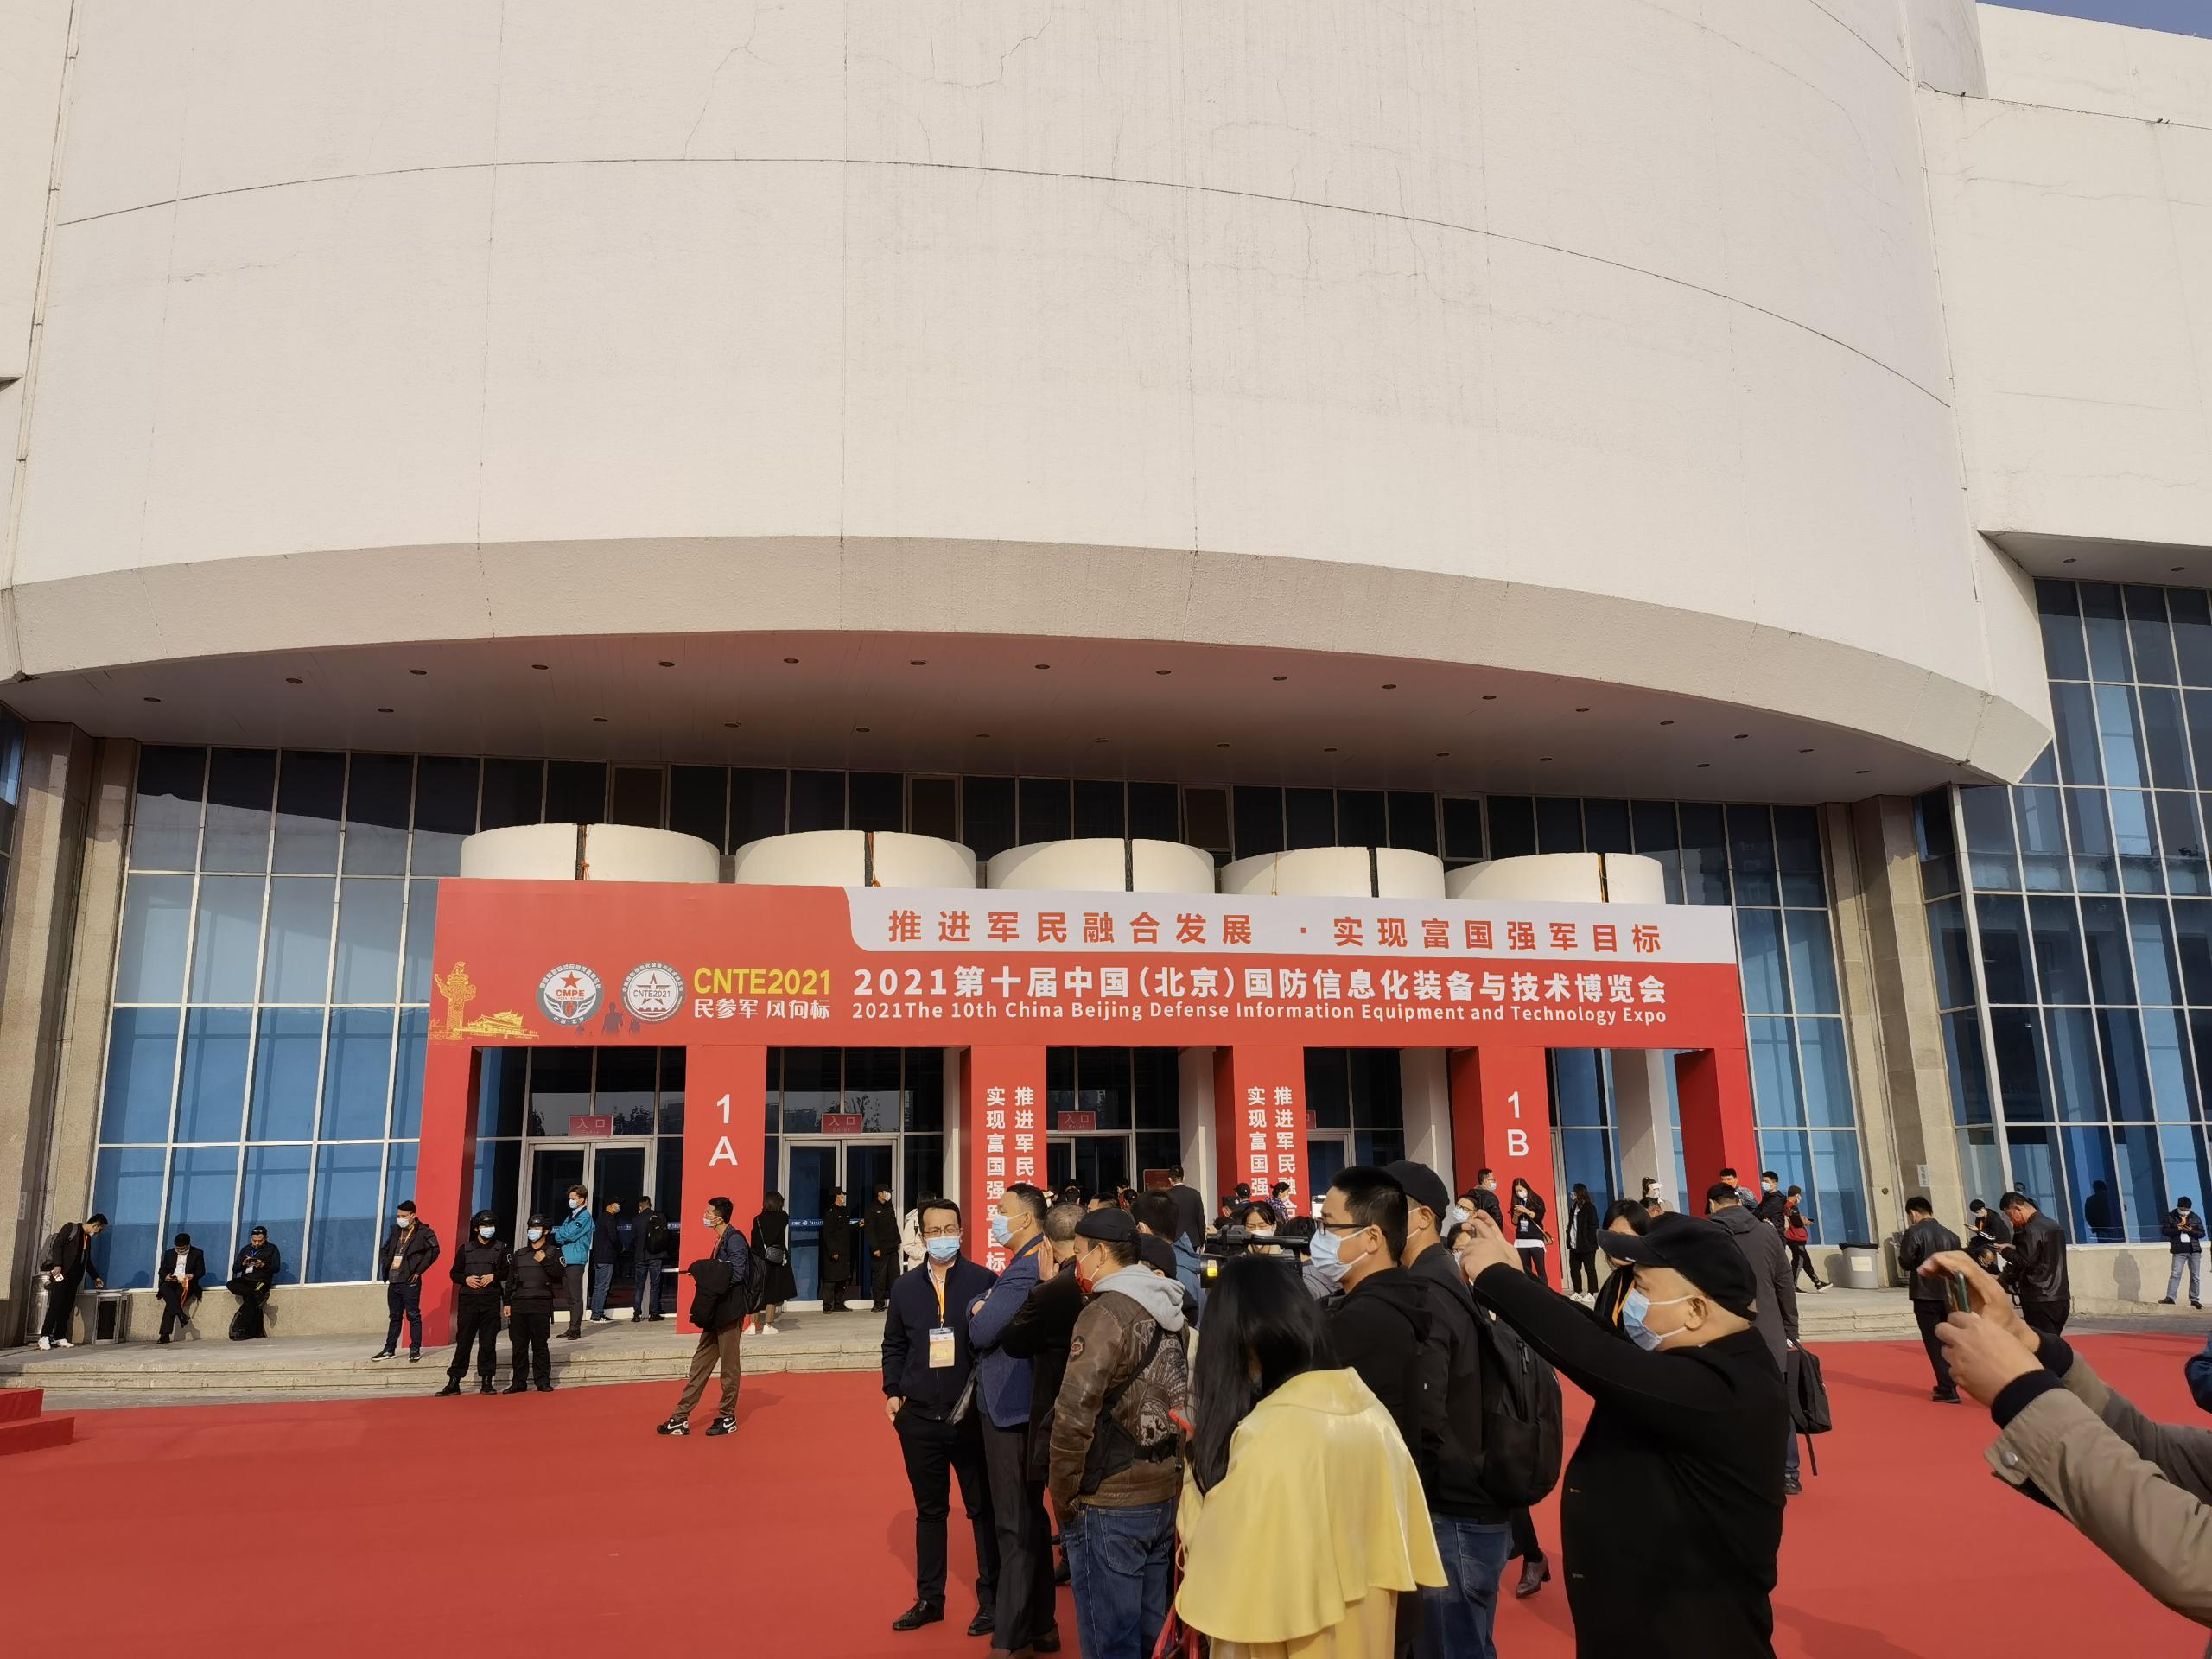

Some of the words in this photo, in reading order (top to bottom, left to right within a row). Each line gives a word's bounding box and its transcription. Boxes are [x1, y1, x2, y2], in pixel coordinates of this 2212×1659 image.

[888, 910, 1252, 944] 推进军民融合发展
[1333, 916, 1662, 953] 实现富国强军目标
[633, 989, 671, 998] CNTE2021
[694, 967, 830, 995] CNTE2021
[694, 998, 758, 1019] 民参军
[766, 999, 830, 1020] 风向标
[951, 1001, 997, 1018] 10th
[1005, 1001, 1064, 1018] China
[1071, 1001, 1142, 1022] Beijing
[1150, 1001, 1229, 1018] Defense
[1236, 1001, 1354, 1019] Information
[1361, 1003, 1465, 1023] Equipment
[1471, 1004, 1504, 1020] and
[1510, 1005, 1617, 1026] Technology
[1623, 1007, 1667, 1026] Expo
[716, 1093, 731, 1124] 1
[1065, 1113, 1089, 1124] 入口
[1507, 1090, 1520, 1119] 1
[576, 1118, 606, 1128] 入口
[829, 1116, 855, 1126] 入口
[1014, 1086, 1035, 1185] 推进军民
[1247, 1086, 1270, 1197] 实现富国强
[1507, 1128, 1529, 1156] B
[709, 1135, 739, 1166] A
